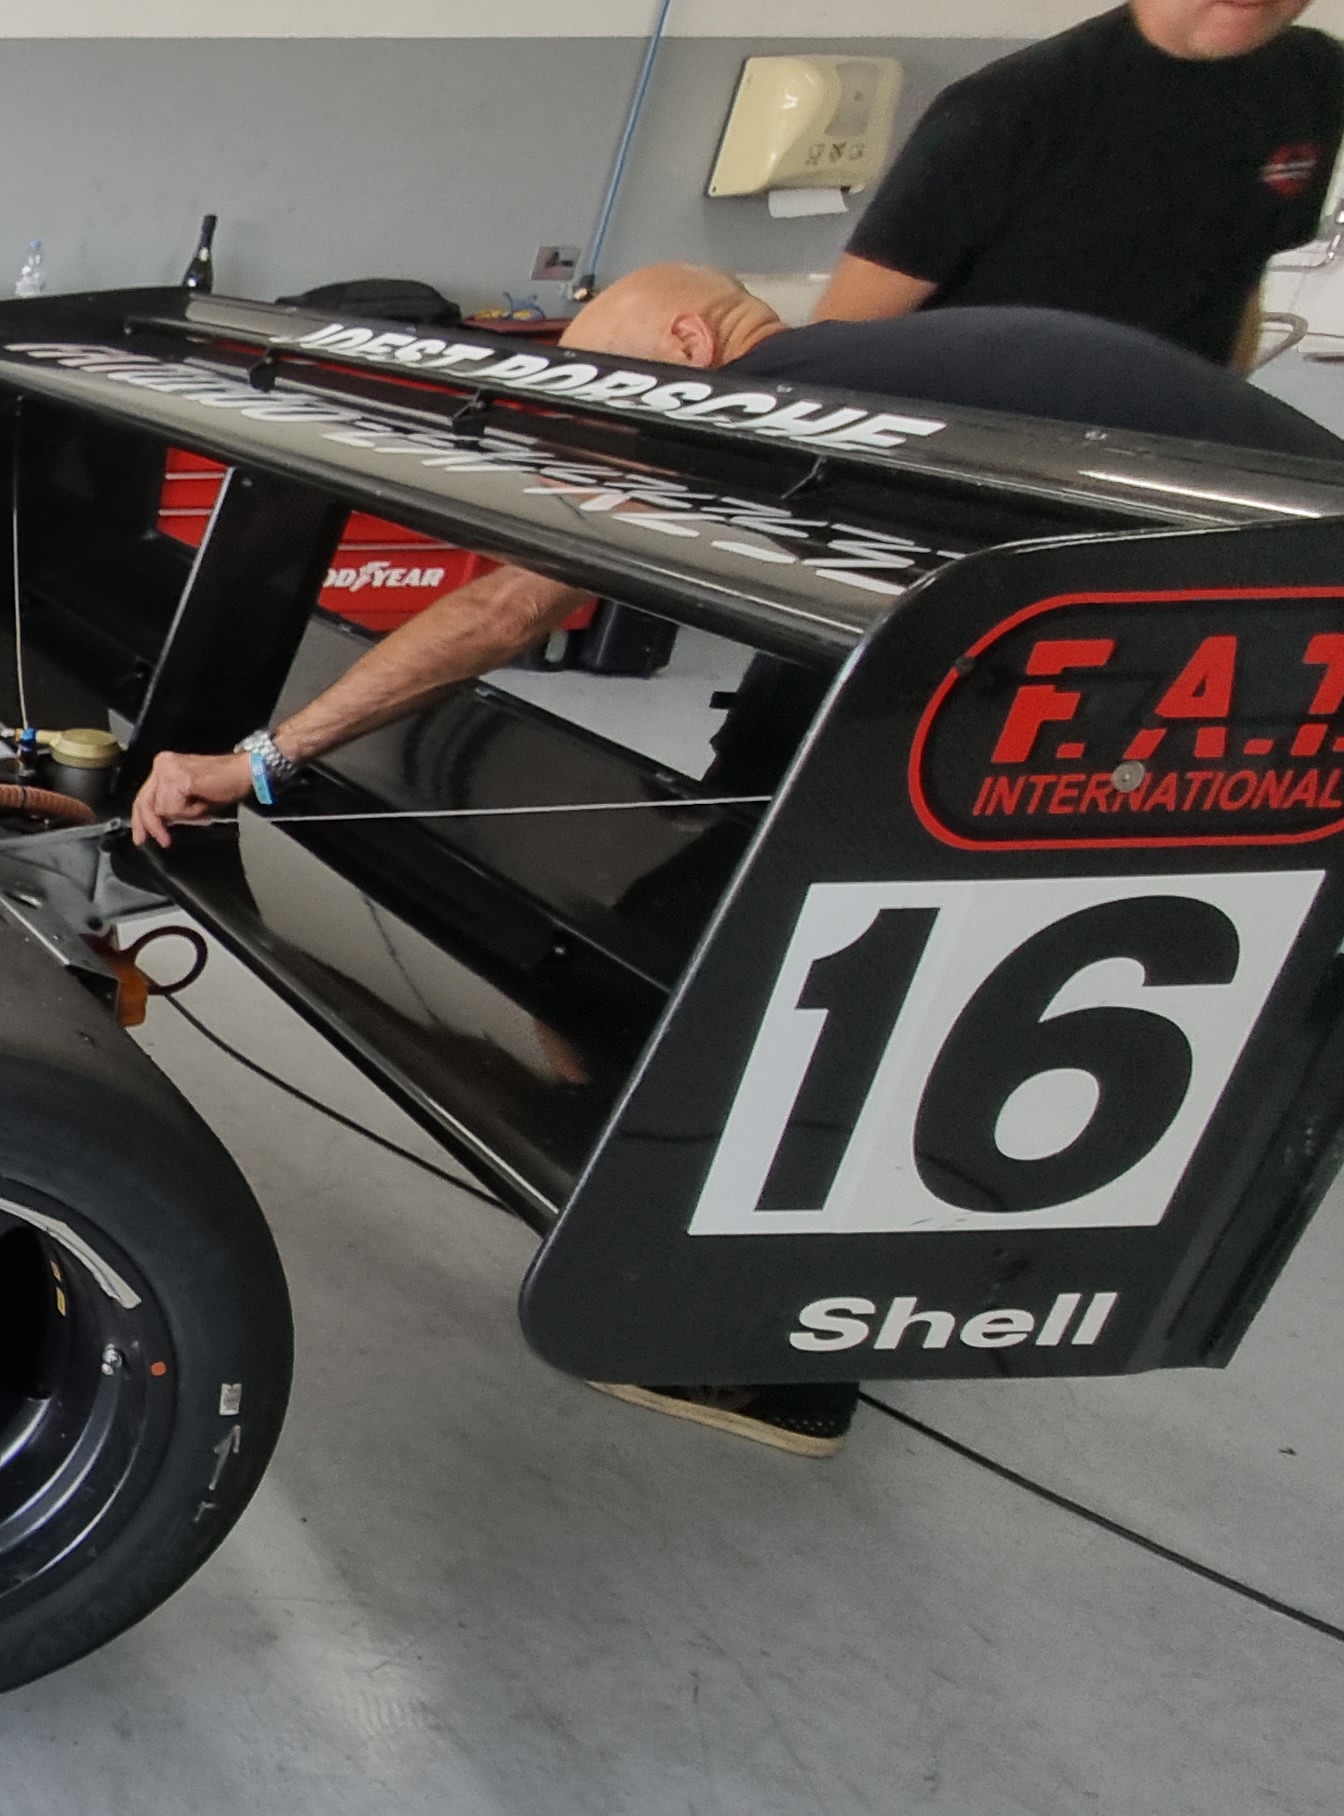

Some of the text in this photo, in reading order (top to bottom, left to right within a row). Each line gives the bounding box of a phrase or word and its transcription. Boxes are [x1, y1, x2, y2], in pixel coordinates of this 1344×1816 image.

[270, 322, 947, 456] JOEST PORSCHE
[971, 767, 1344, 816] INTERNATIONAL
[753, 893, 1242, 1215] 16
[788, 1292, 1118, 1352] Shell
